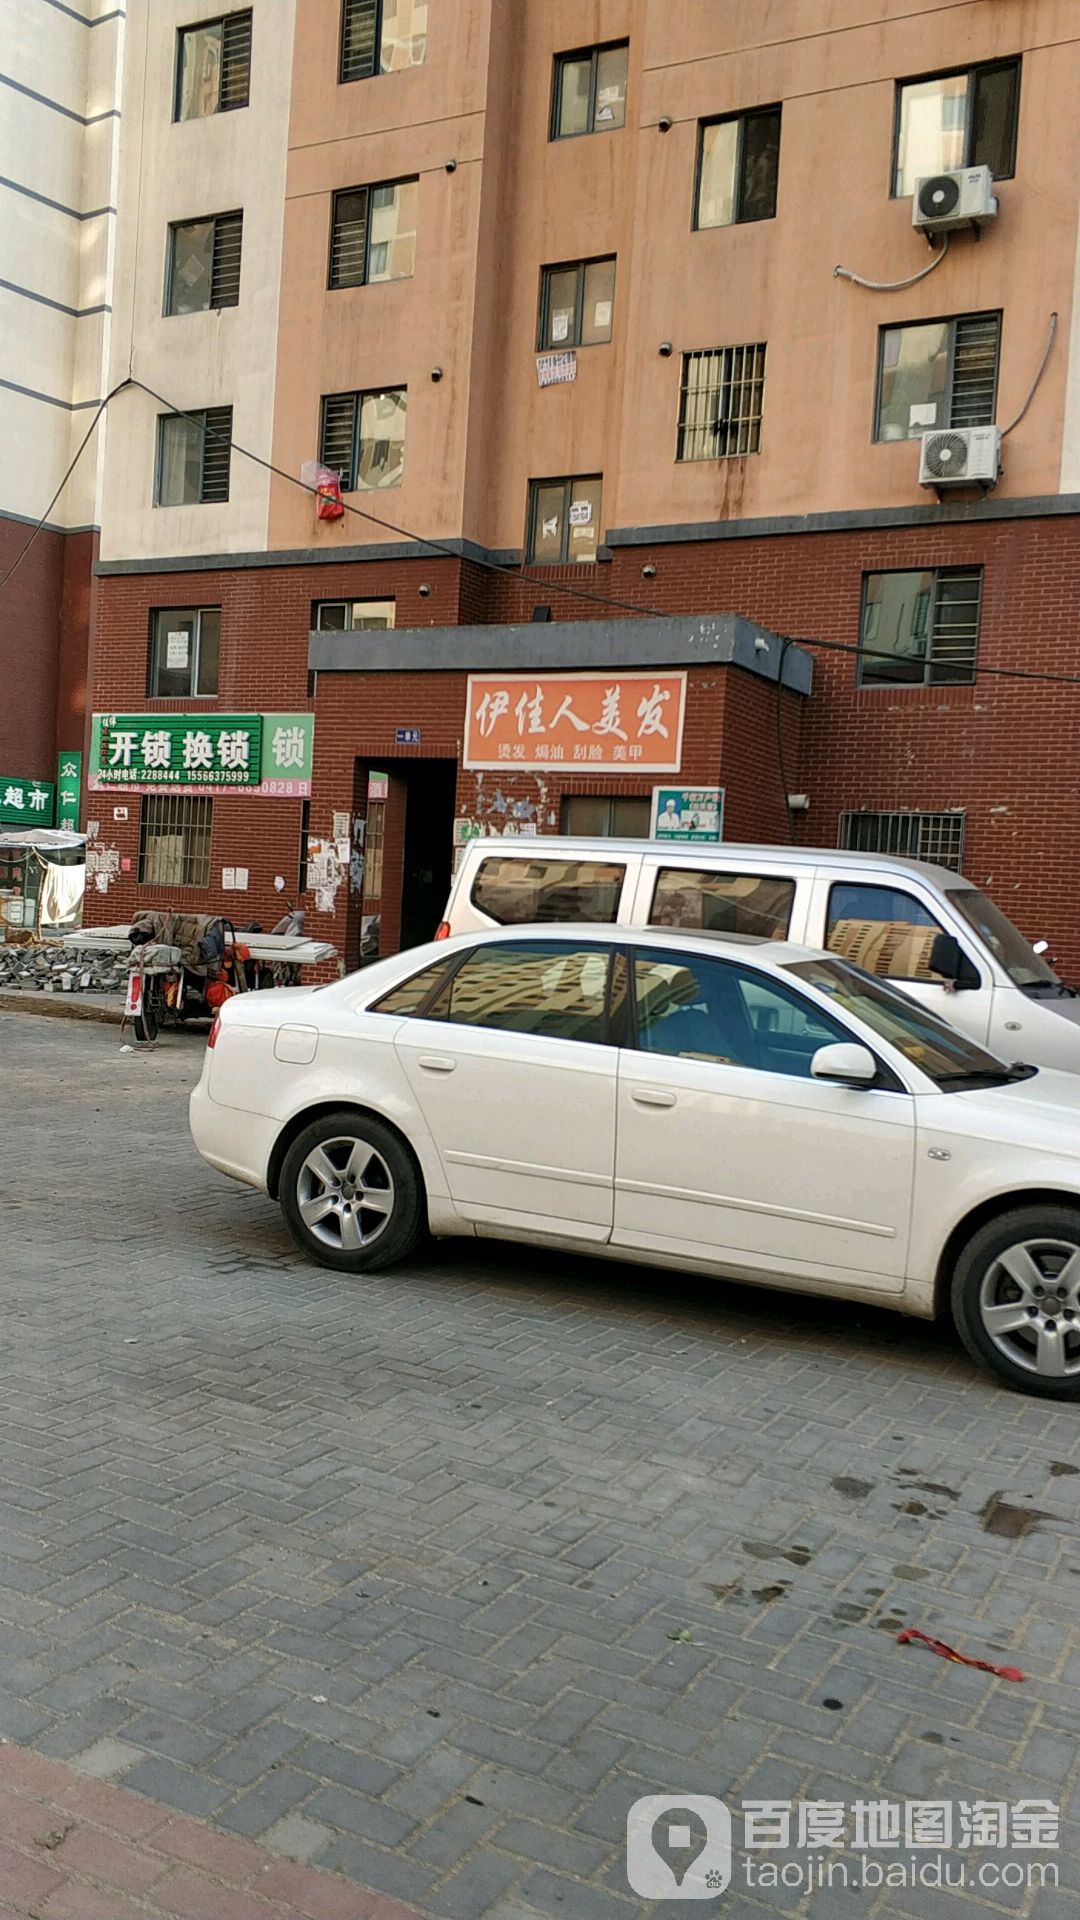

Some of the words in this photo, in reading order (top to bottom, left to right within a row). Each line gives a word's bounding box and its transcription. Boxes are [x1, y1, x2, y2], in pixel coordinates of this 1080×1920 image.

[475, 684, 671, 741] 伊佳人美发
[108, 730, 172, 768] 开锁
[182, 730, 249, 769] 换锁
[272, 727, 305, 768] 锁
[497, 743, 526, 759] 烫发
[534, 744, 564, 760] 焗油
[573, 744, 603, 760] 刮脸
[612, 744, 643, 761] 美甲
[187, 770, 249, 782] 15566375999
[3, 786, 49, 811] 超市
